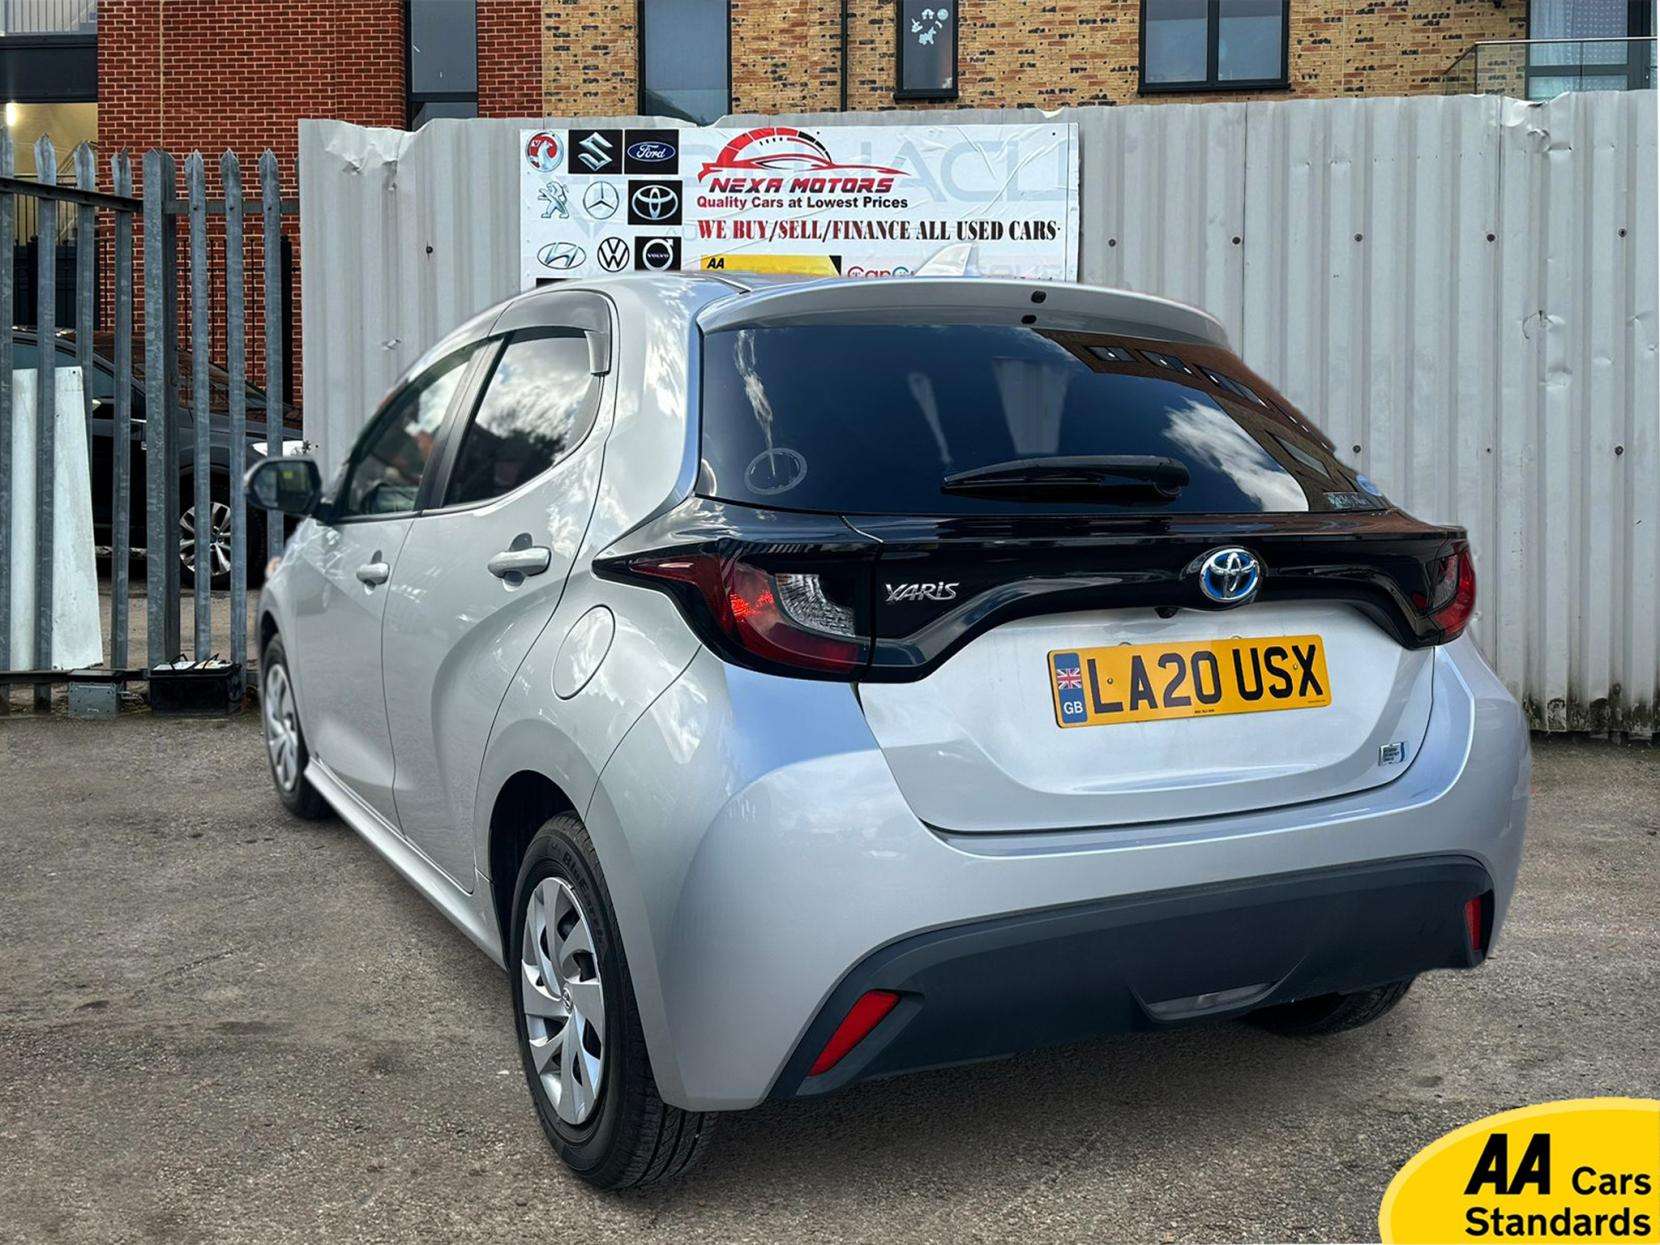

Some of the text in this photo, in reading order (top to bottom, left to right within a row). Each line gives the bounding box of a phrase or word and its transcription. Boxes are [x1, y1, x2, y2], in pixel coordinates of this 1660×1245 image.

[636, 144, 666, 159] Ford
[709, 177, 894, 194] NEXA MOTORS
[697, 195, 908, 211] Quality Cars at Lowest Prices
[697, 219, 1057, 242] WE BUY/SELL/FINANCE ALL USED CARS
[706, 257, 725, 270] AA
[1086, 643, 1324, 715] LA20 USX
[1063, 700, 1084, 716] GB
